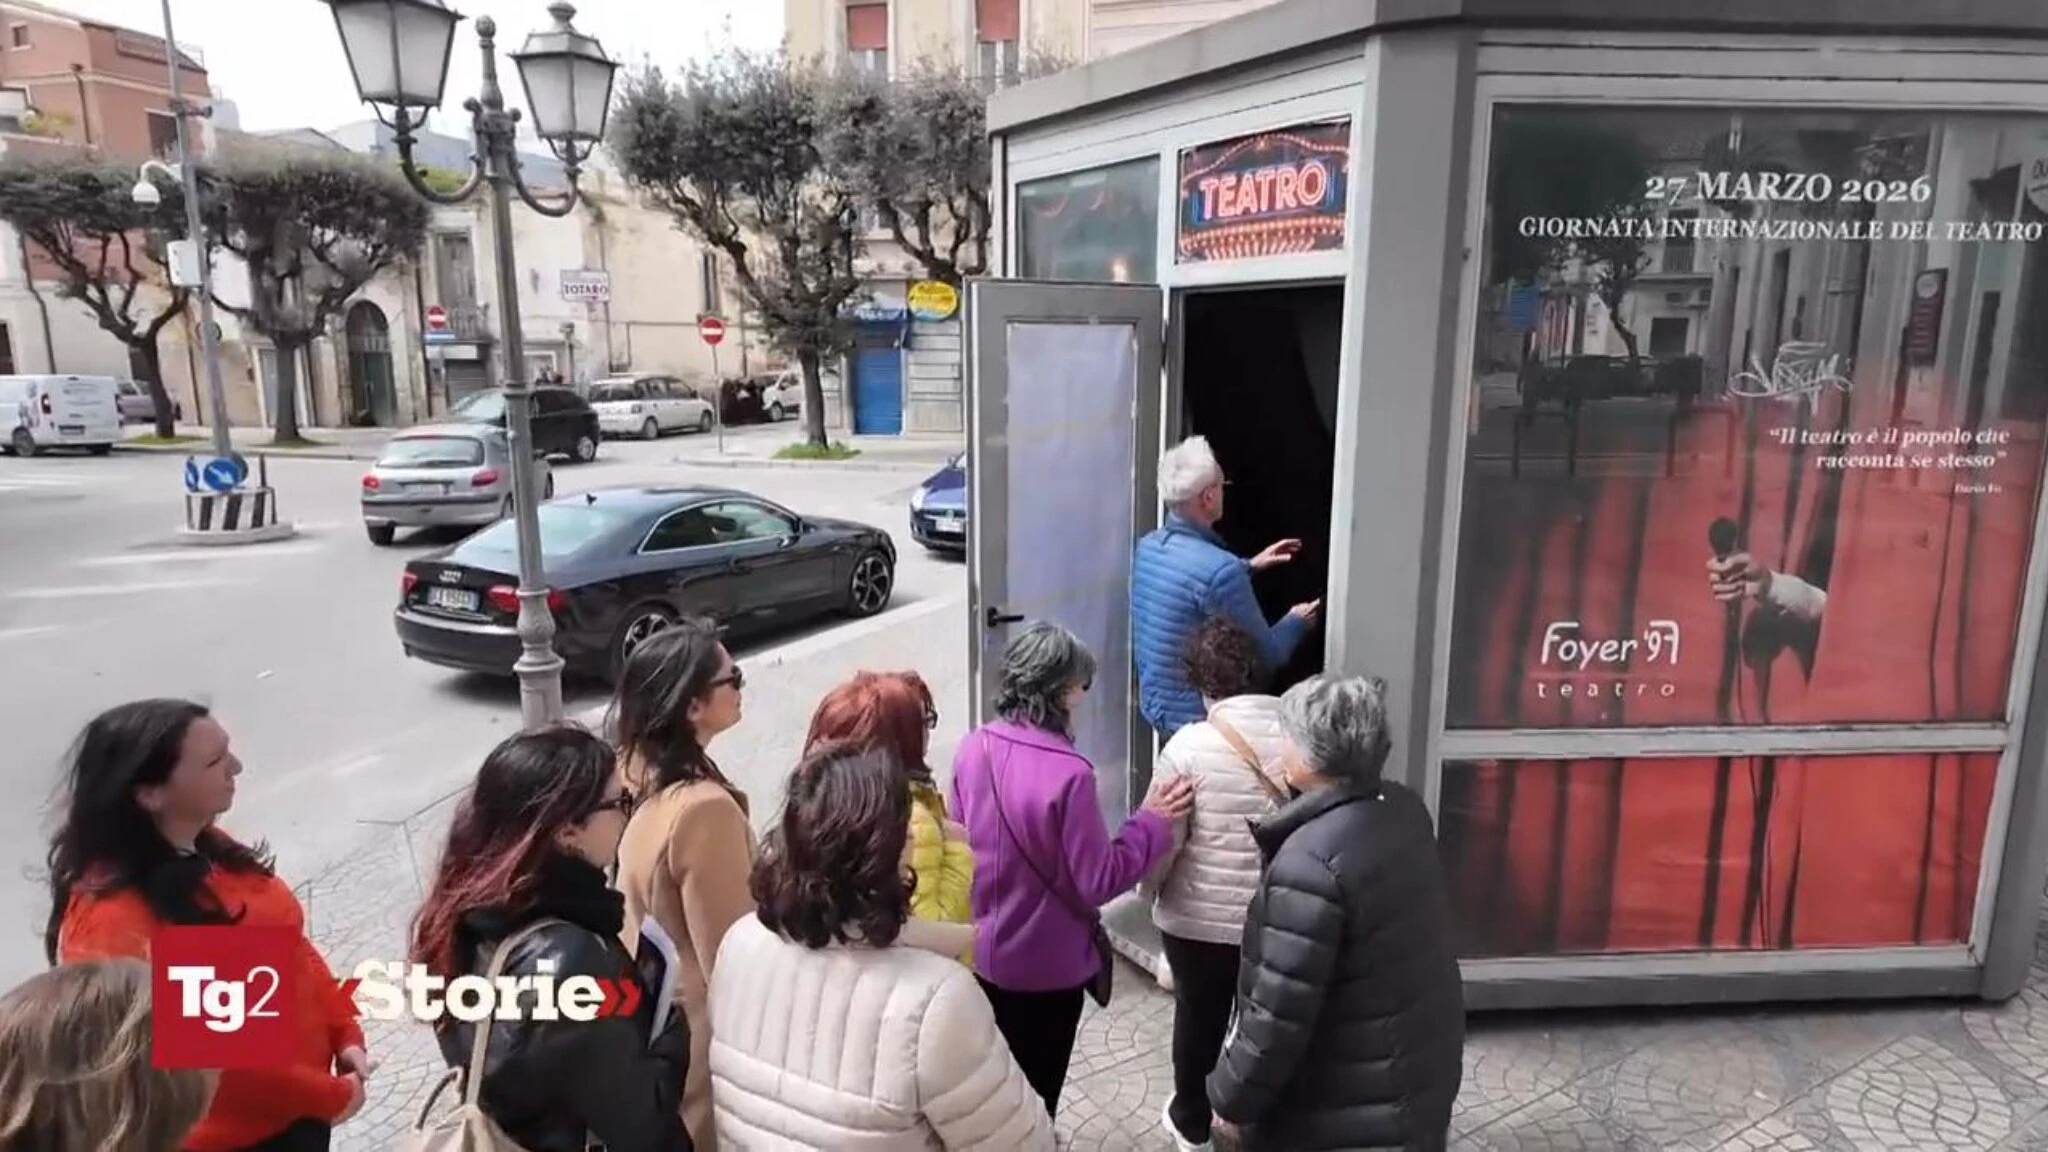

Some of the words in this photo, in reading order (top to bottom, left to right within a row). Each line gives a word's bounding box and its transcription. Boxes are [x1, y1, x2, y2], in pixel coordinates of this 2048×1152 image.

[1200, 160, 1327, 220] TEATRO
[1644, 175, 1688, 206] 27
[1697, 171, 1832, 201] MARZO
[1840, 174, 1932, 203] 2026
[1519, 216, 1655, 238] GIORNATA
[1660, 218, 1884, 240] INTERNAZIONALE
[1890, 220, 1935, 241] DEL
[1946, 220, 2043, 242] TEATRO
[1800, 429, 1862, 444] teatro
[1867, 429, 1880, 444] è
[1883, 427, 1899, 444] il
[1901, 429, 1972, 449] popolo
[1816, 451, 1905, 469] racconta
[1911, 453, 1933, 469] se
[1541, 622, 1638, 671] Foyer
[1537, 683, 1675, 698] teatro
